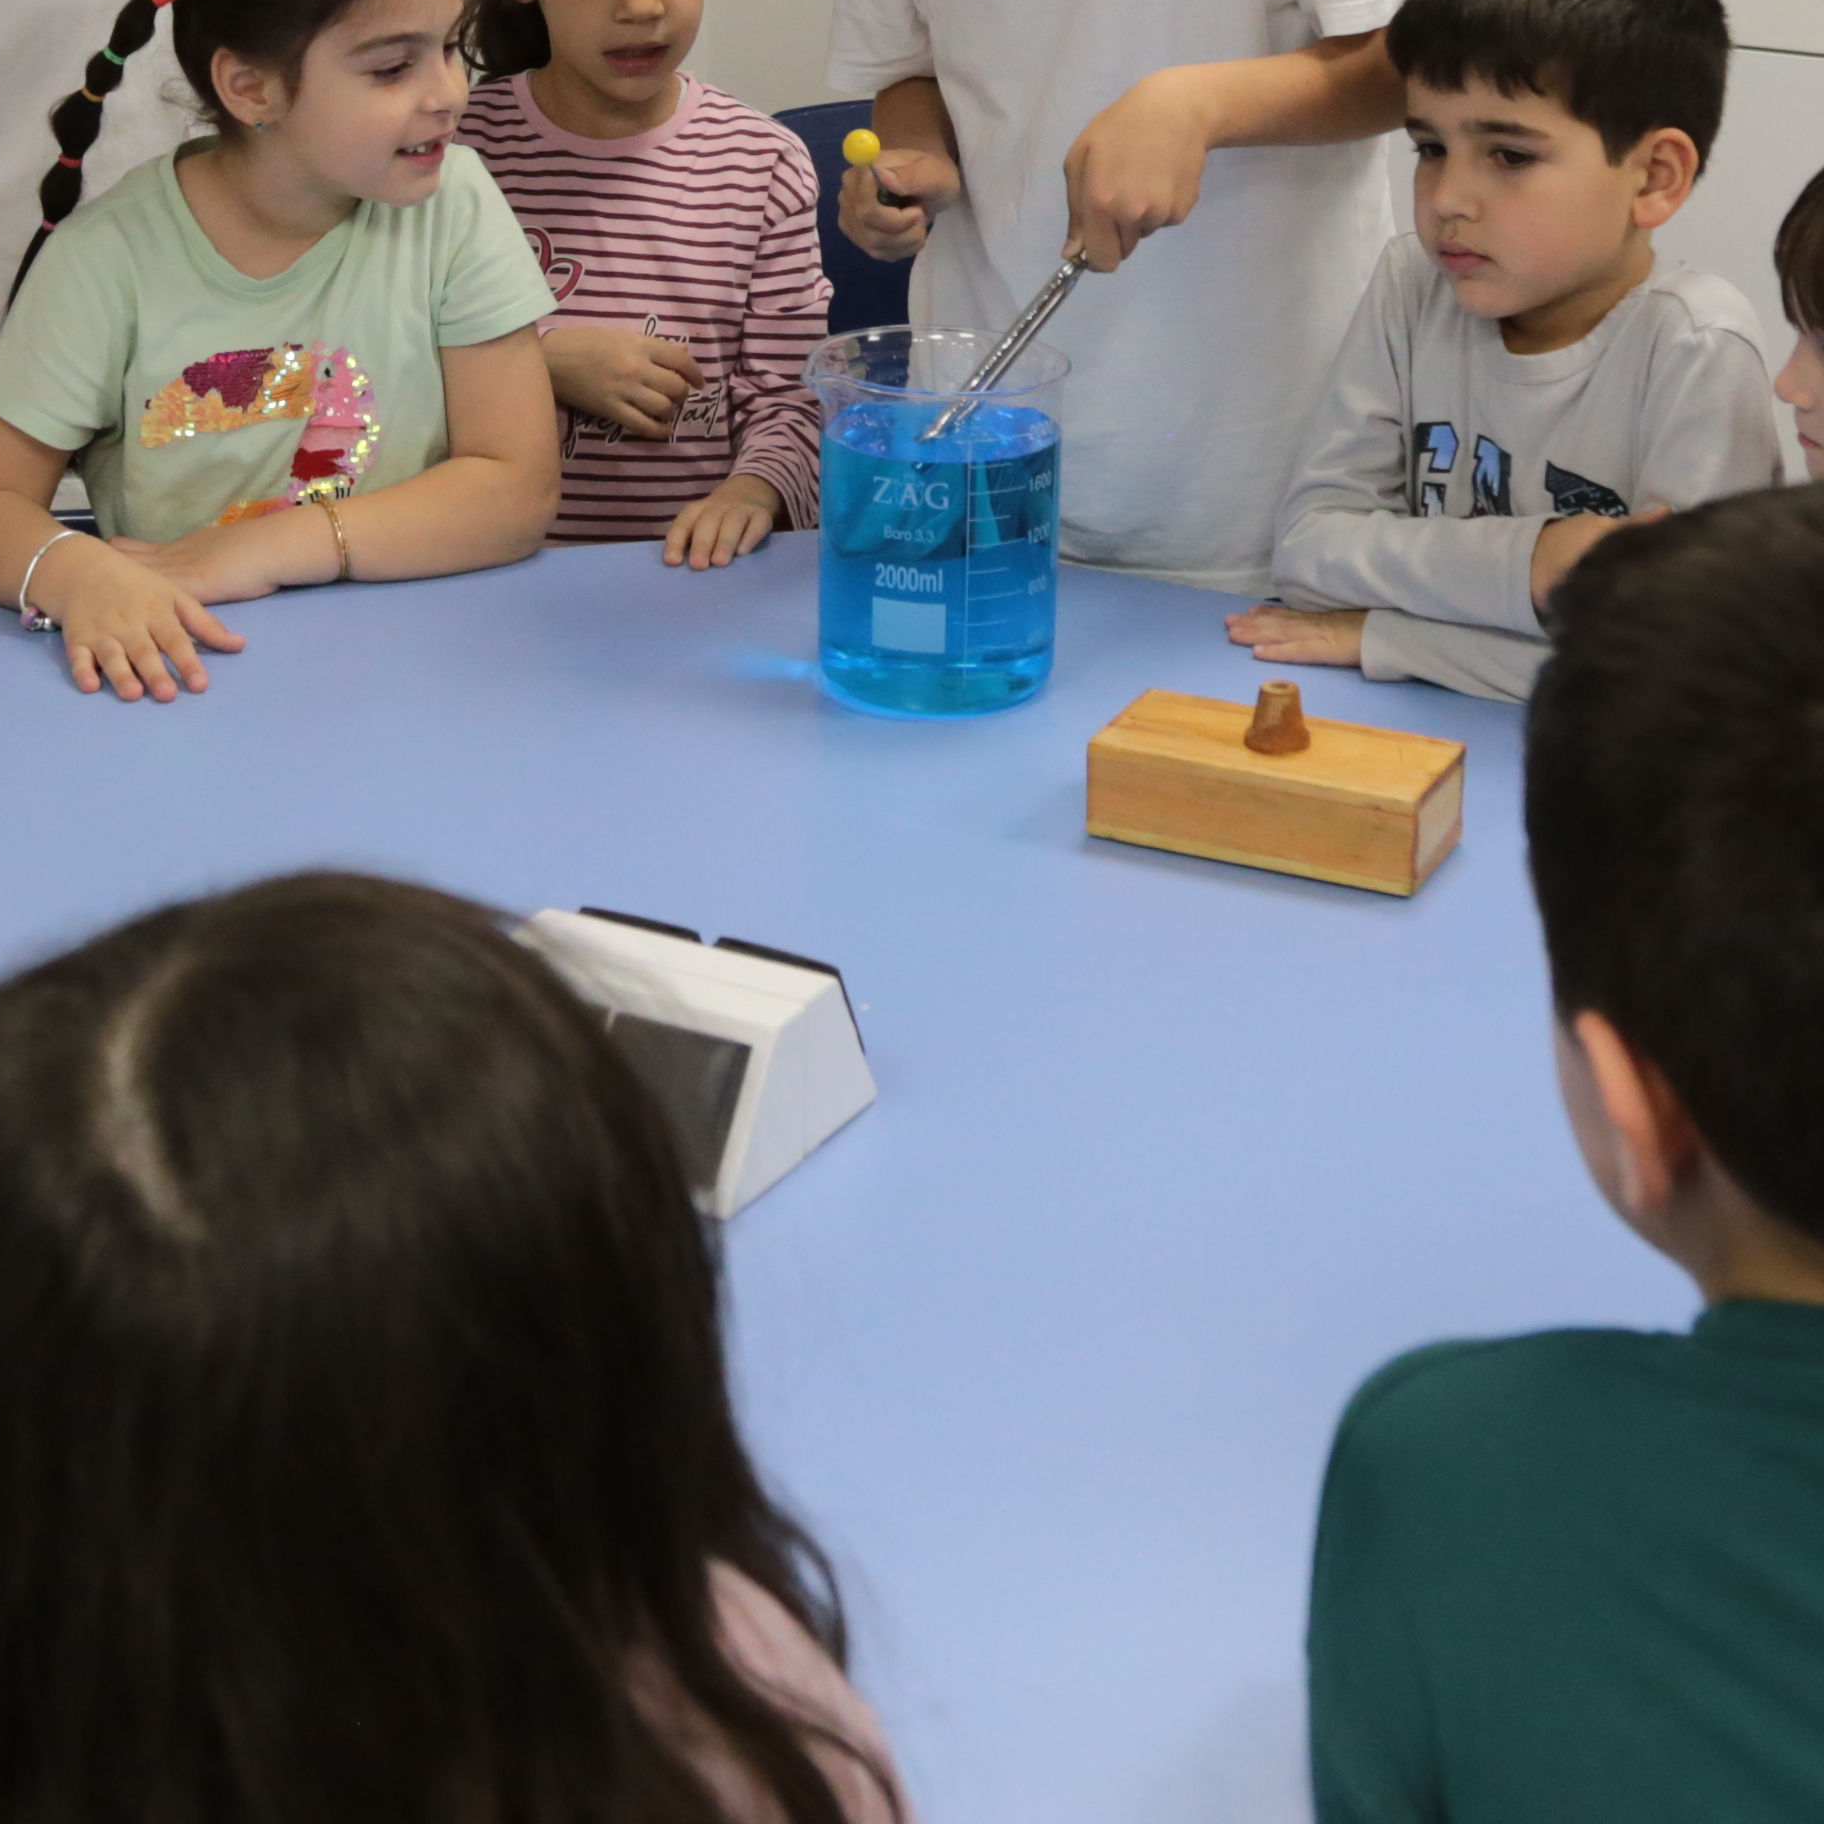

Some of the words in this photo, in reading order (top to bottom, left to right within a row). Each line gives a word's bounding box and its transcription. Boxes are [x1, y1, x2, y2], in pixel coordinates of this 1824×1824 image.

[873, 476, 949, 510] ZAG
[1028, 471, 1052, 493] 1600
[883, 525, 912, 542] Boro
[1027, 523, 1051, 545] 1200
[875, 562, 943, 594] 2000ml
[1028, 574, 1047, 596] 800
